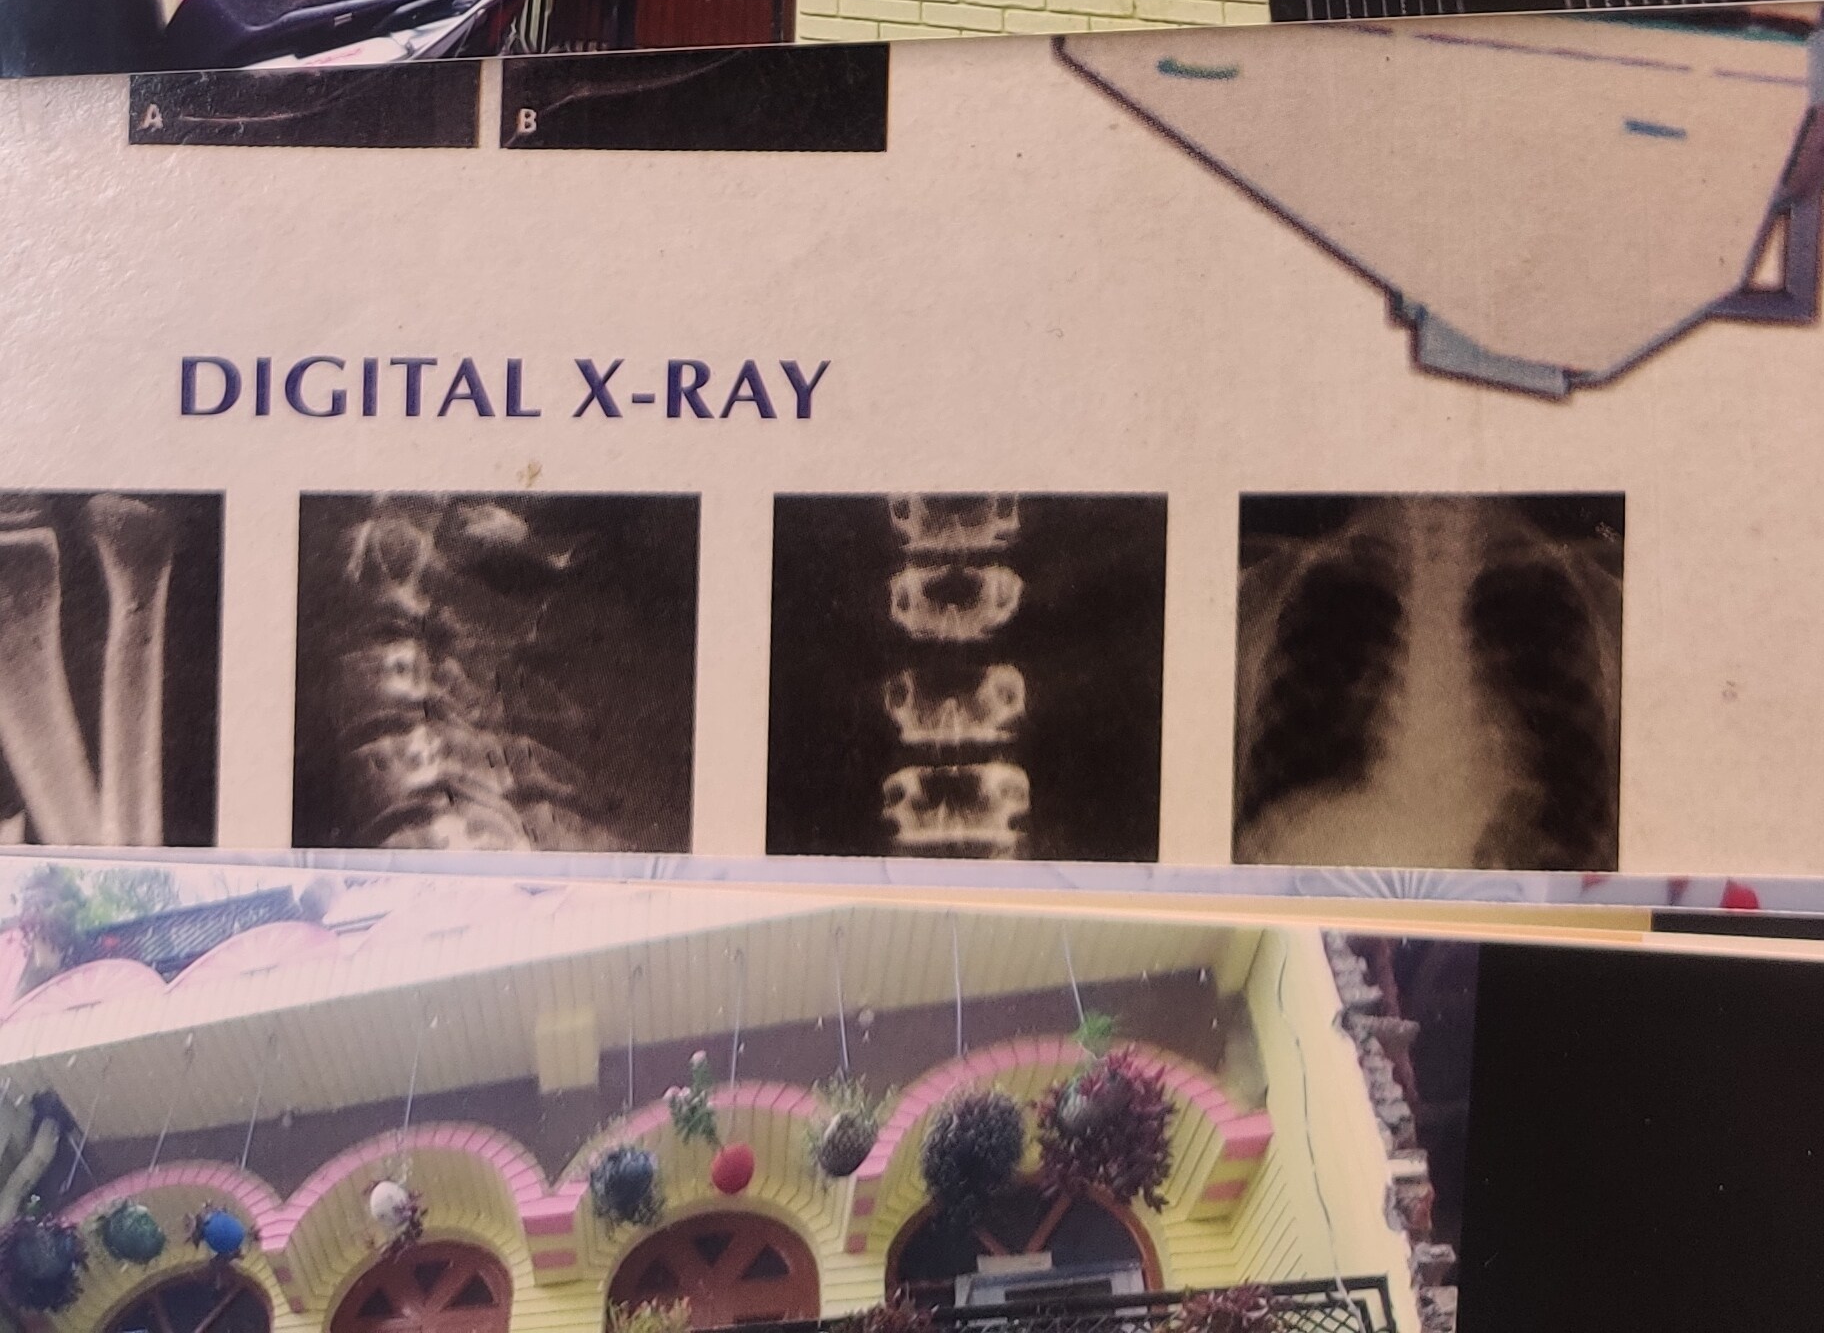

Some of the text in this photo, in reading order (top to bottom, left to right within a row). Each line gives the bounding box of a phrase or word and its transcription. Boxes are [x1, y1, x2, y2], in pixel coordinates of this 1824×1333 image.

[142, 104, 163, 131] A
[517, 109, 537, 134] B
[180, 355, 832, 420] DIGITAL X-RAY
